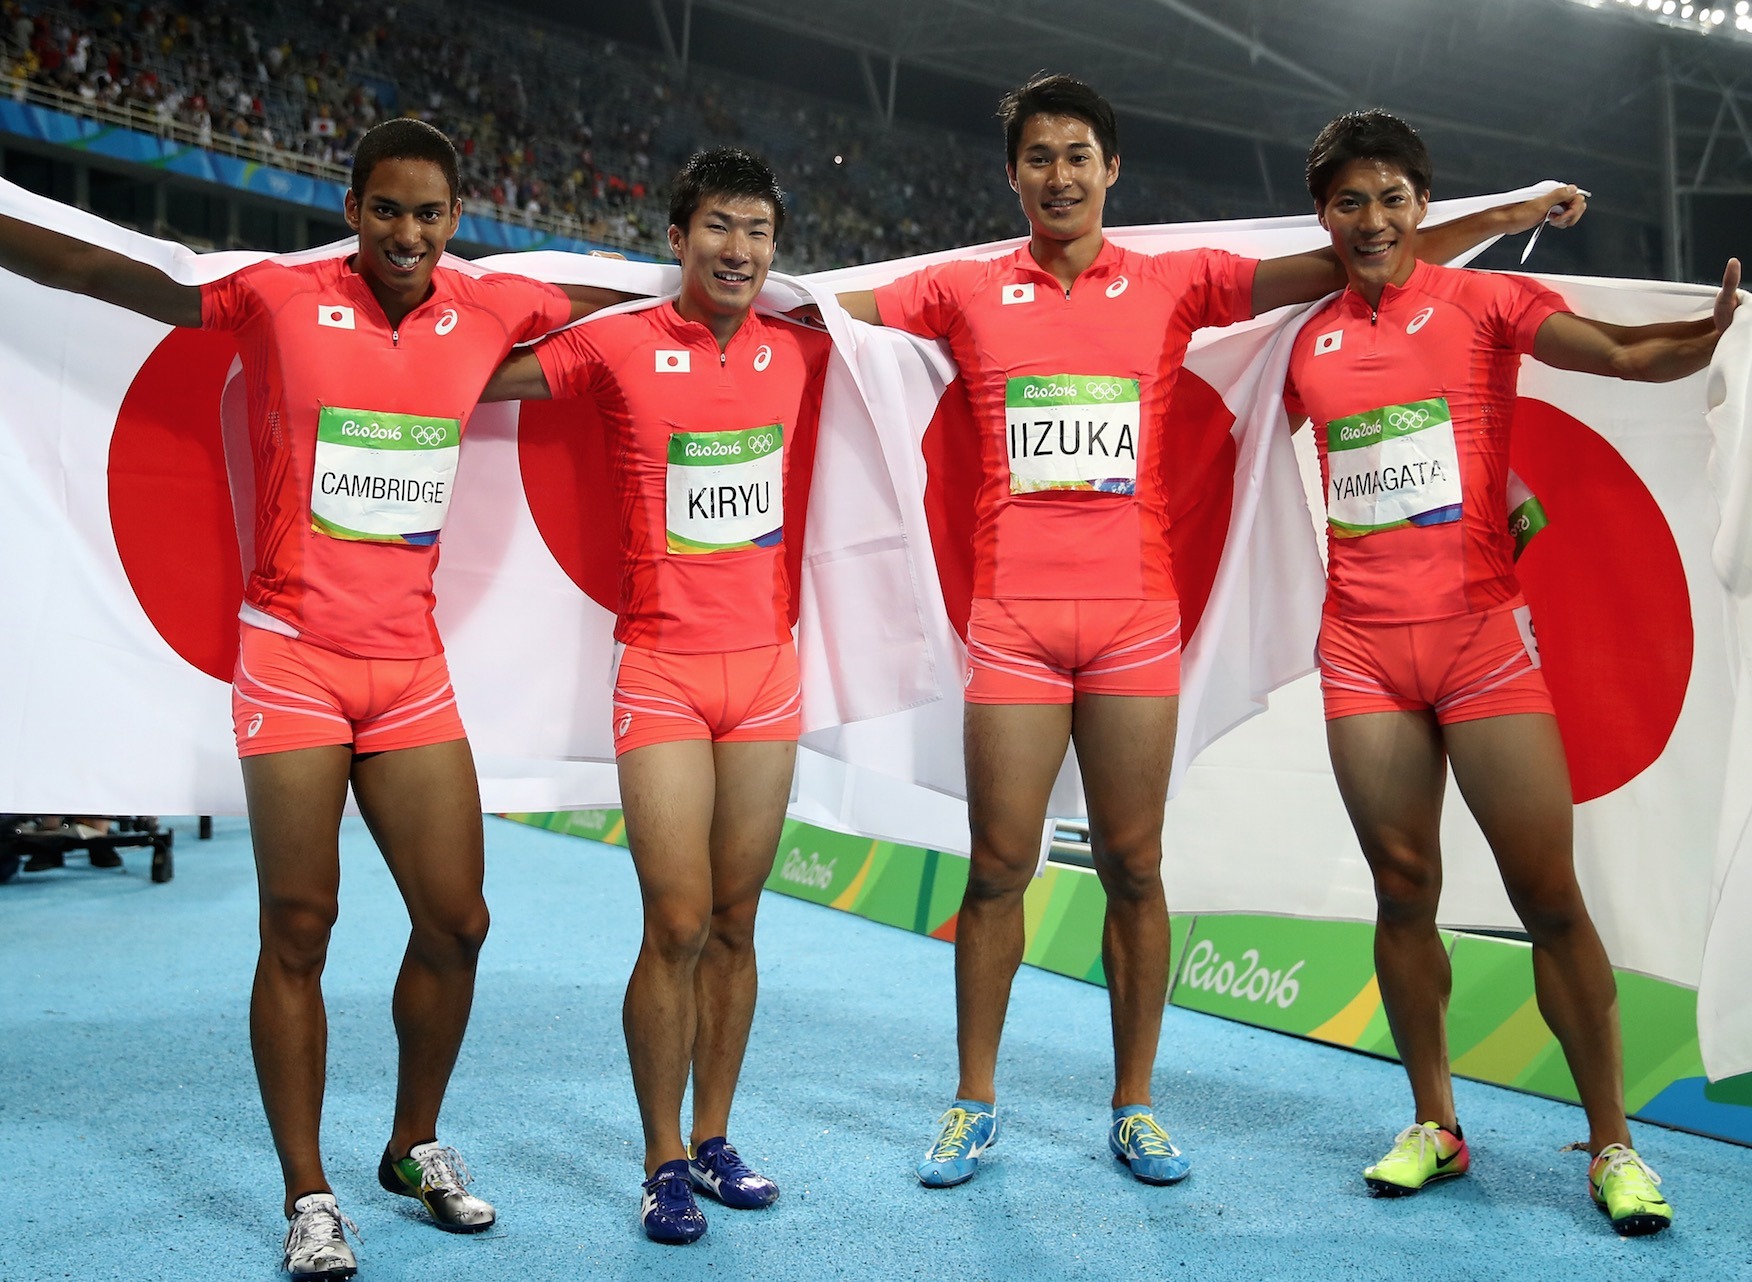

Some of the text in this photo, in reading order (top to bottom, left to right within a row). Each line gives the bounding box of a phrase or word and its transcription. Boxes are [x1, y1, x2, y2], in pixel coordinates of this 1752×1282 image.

[1024, 383, 1077, 398] Rio2016
[341, 420, 402, 441] Rio2016
[1011, 420, 1135, 460] IIZUKA
[1340, 418, 1382, 441] Rio2016
[685, 440, 741, 457] Rio2016
[321, 471, 445, 504] CAMBRIDGE
[1332, 460, 1447, 501] YAMAGATA
[688, 481, 769, 519] KIRYU
[1181, 939, 1306, 1009] Rio2016
